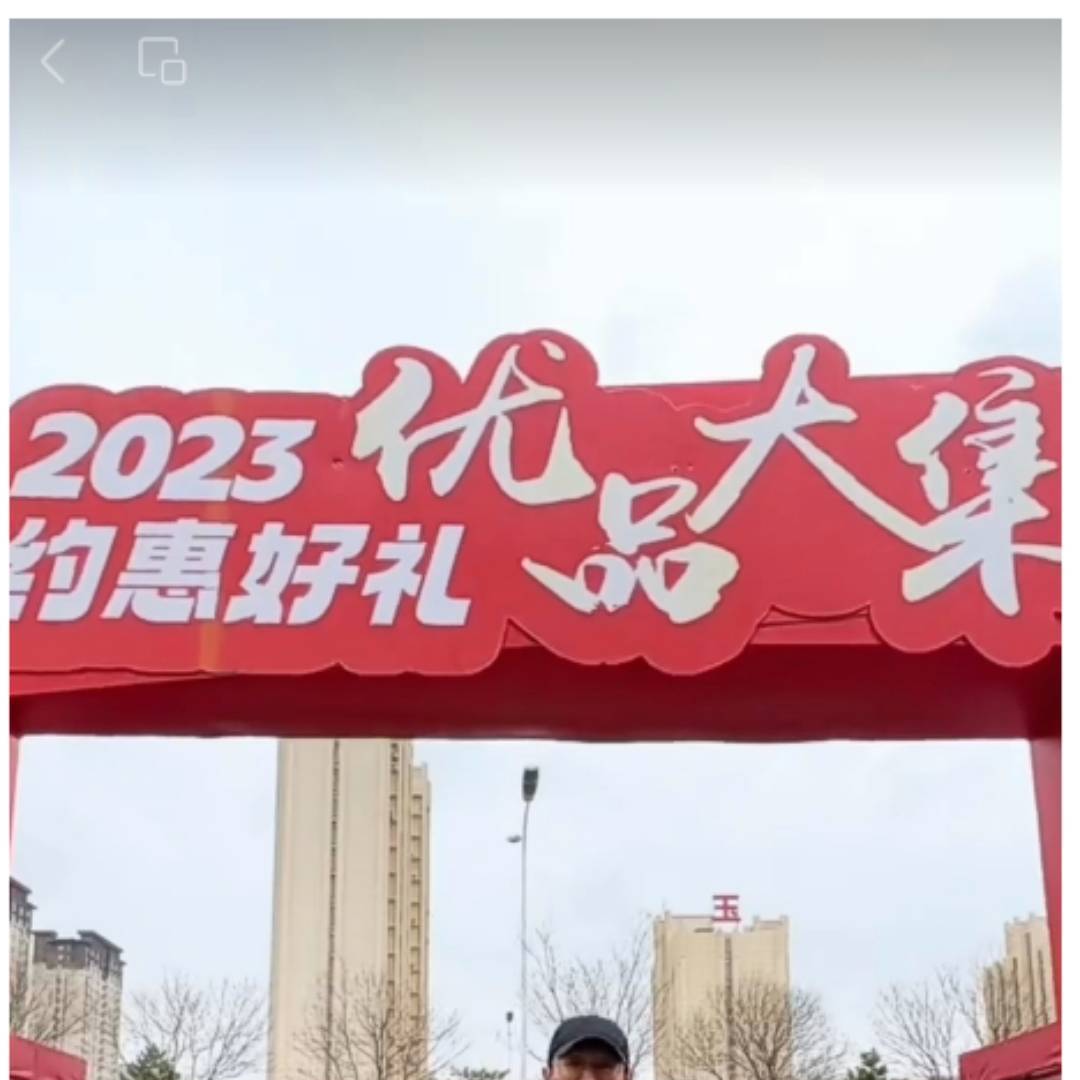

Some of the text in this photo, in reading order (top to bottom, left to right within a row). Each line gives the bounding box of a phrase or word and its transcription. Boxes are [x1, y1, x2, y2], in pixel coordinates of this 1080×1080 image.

[10, 411, 316, 502] 2023
[352, 339, 1061, 625] 优品大集
[10, 518, 470, 626] 约惠好礼
